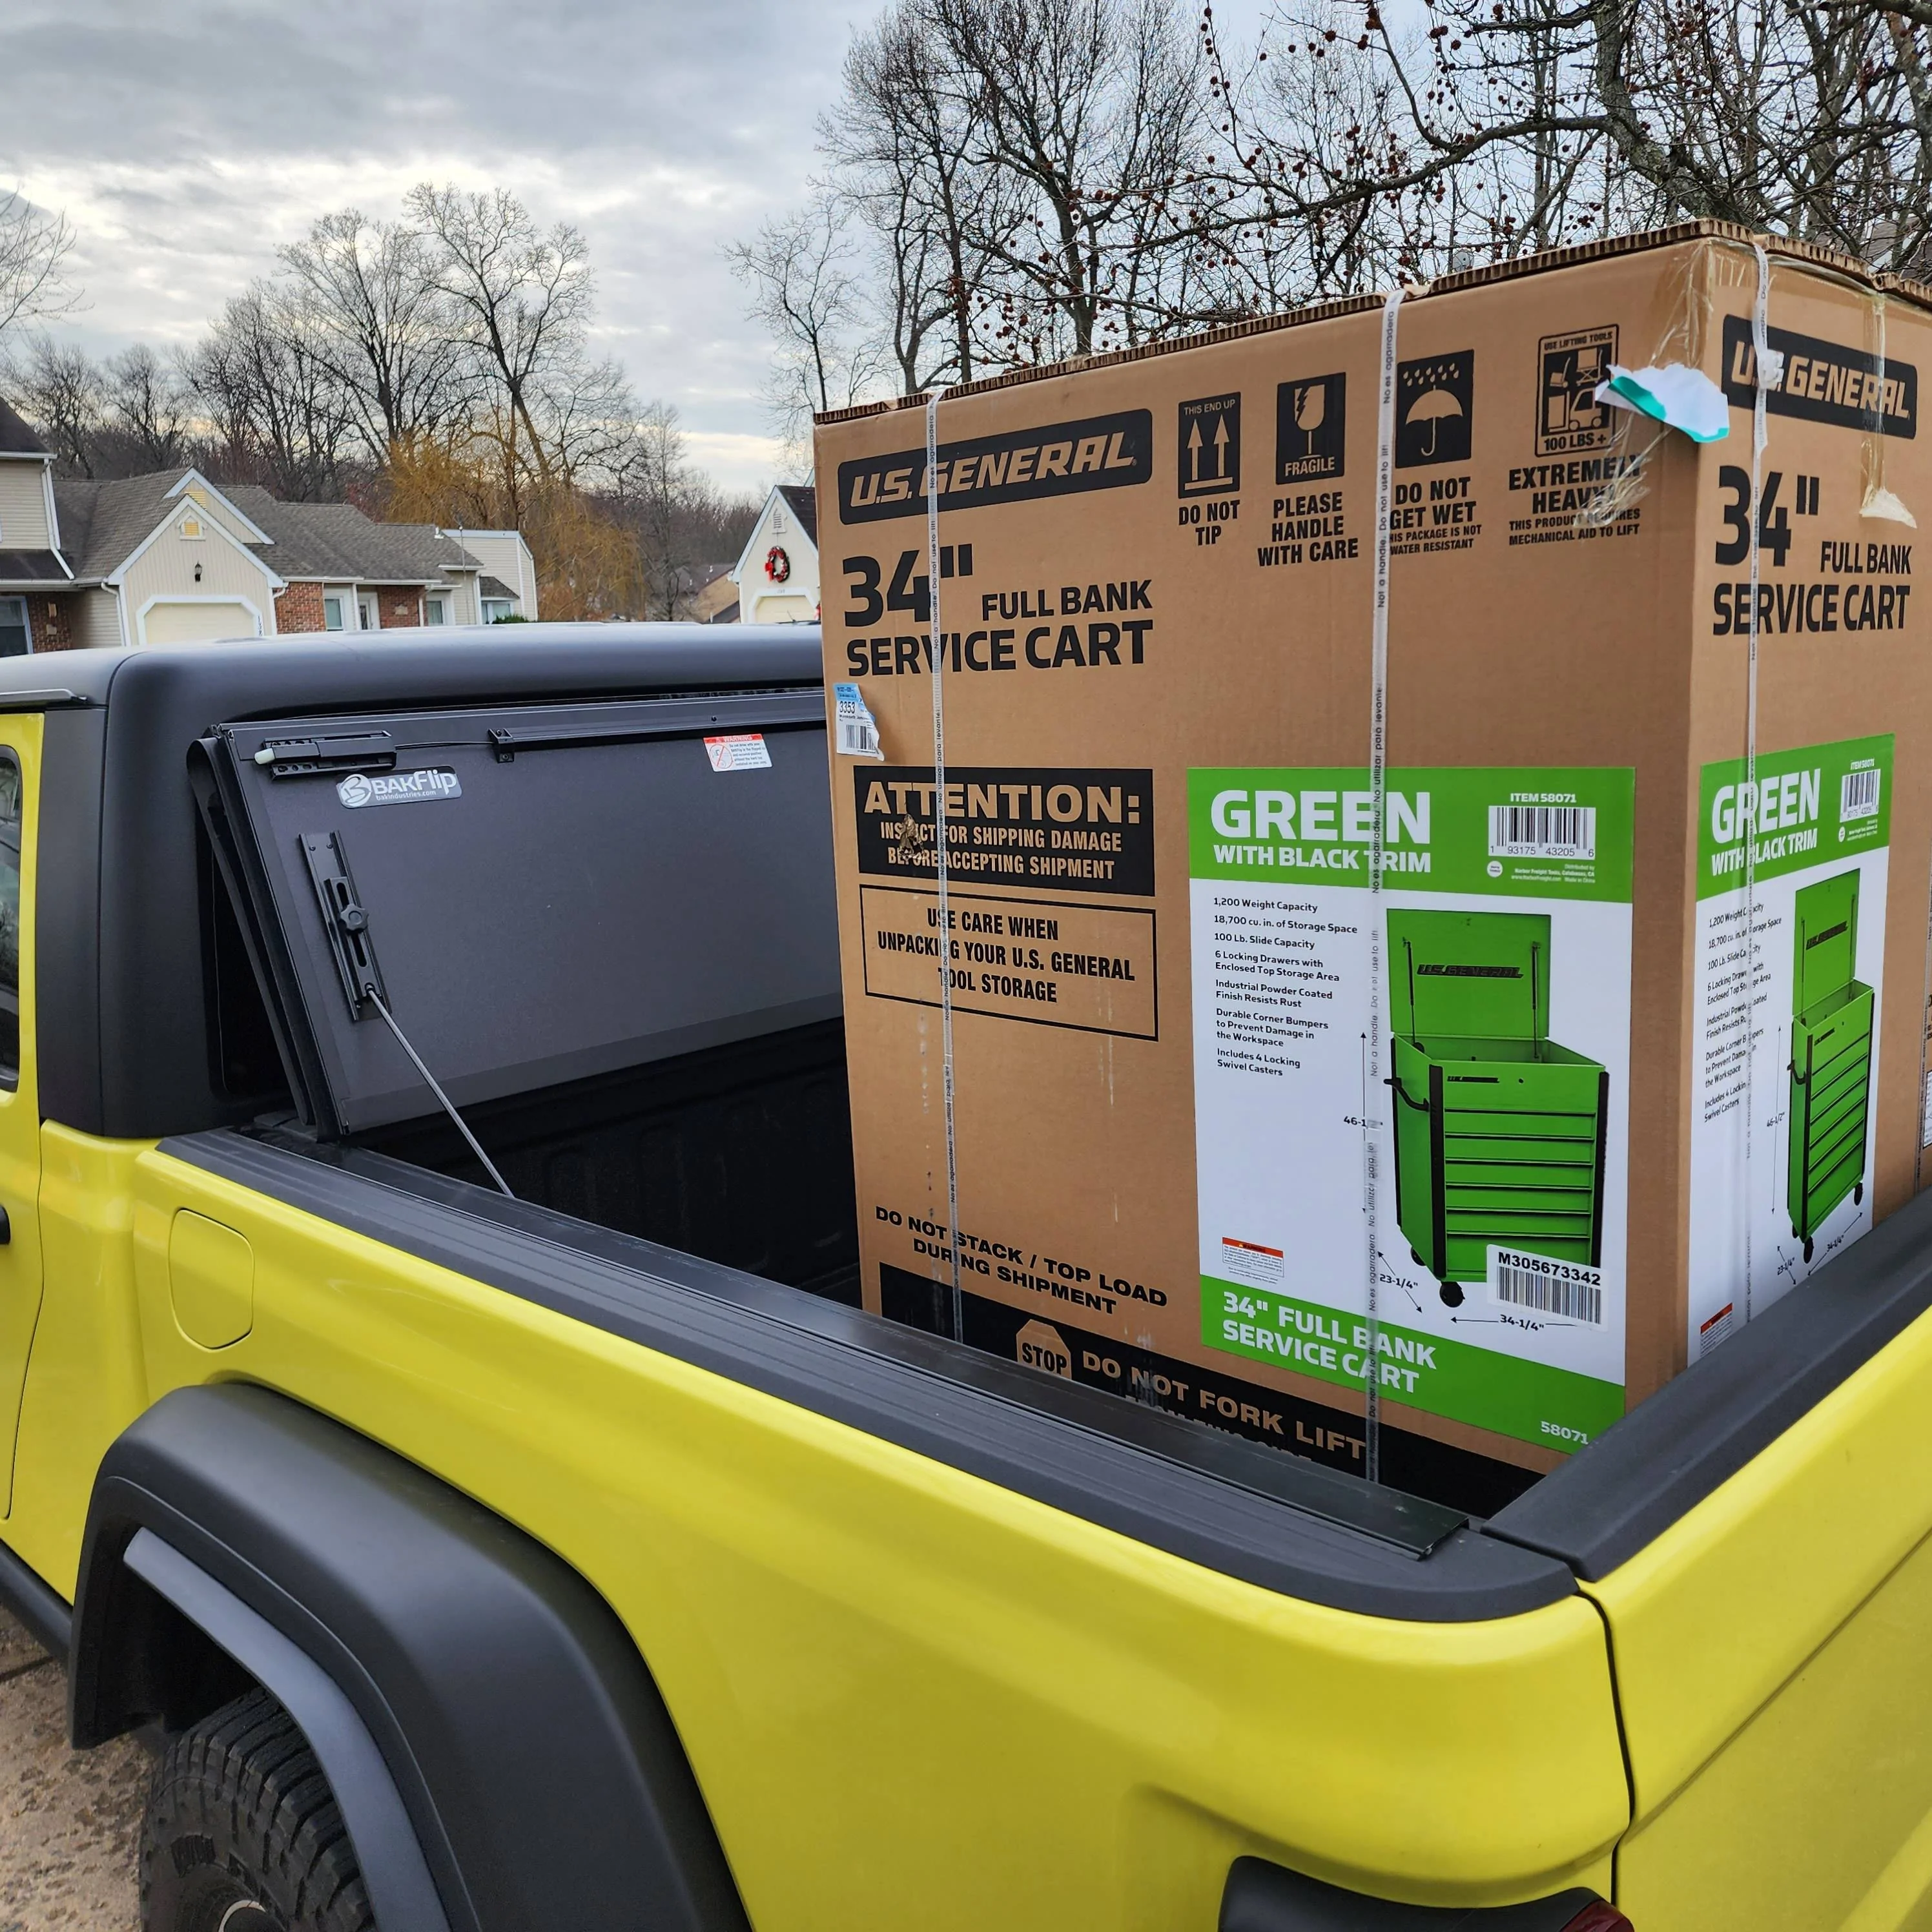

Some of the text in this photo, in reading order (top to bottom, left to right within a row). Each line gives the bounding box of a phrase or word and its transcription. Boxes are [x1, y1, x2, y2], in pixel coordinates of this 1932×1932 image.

[1786, 355, 1910, 419] GENERAL
[1184, 399, 1236, 416] THIS END UP
[1544, 432, 1595, 451] 100 LBS
[917, 431, 1135, 496] GENERAL
[1285, 457, 1335, 477] FRAGILE
[1395, 477, 1471, 505] DO NOT
[1179, 500, 1240, 526] DO NOT
[1273, 491, 1342, 519] PLEASE
[1390, 500, 1476, 530] GET WET
[1715, 465, 1820, 568] 34"
[1196, 525, 1222, 546] TIP
[1272, 516, 1344, 542] HANDLE
[1406, 524, 1482, 542] PACKAGE IS NOT
[1509, 520, 1532, 531] THIS
[1509, 524, 1640, 546] MECHANICAL AID TO LIFT
[1258, 538, 1358, 567] WITH CARE
[1390, 539, 1474, 556] WATER RESISTANT
[1820, 541, 1912, 575] FULL BANK
[842, 543, 974, 627] 34"
[981, 579, 1153, 621] FULL BANK
[1713, 583, 1911, 637] SERVICE CART
[847, 619, 1153, 676] SERVICE CART
[839, 701, 856, 714] 3353
[371, 769, 457, 796] BAKFlip
[375, 790, 437, 801] bakindustries.com
[863, 780, 1141, 825] ATTENTION:
[1510, 793, 1577, 803] ITEM 58071
[1711, 768, 1821, 845] GREEN
[1211, 789, 1430, 844] GREEN
[973, 827, 1045, 849] SHIPPING
[1051, 830, 1122, 853] DAMAGE
[1508, 847, 1575, 856] 93175 43205
[1711, 847, 1745, 877] WITH
[1788, 828, 1818, 855] TRIM
[946, 852, 1115, 880] ACCEPTING SHIPMENT
[1213, 844, 1431, 873] WITH BLACK TRIM
[1213, 898, 1318, 914] 1,200 Weight Capacity
[961, 912, 1003, 934] CARE
[1008, 916, 1058, 940] WHEN
[1214, 915, 1358, 934] 18,700 cu. in. of Storage Space
[1215, 933, 1315, 950] 100 Lb. Slide Capacity
[878, 930, 1136, 981] UNPACKIG YOUR U.S. GENERAL
[1223, 951, 1259, 963] Locking
[1260, 954, 1300, 966] Drawers
[1302, 958, 1323, 967] with
[1215, 961, 1340, 981] Enclosed Top Storage Area
[981, 974, 1058, 1002] STORAGE
[1215, 980, 1333, 1000] Industrial Powder Coated
[1216, 991, 1302, 1008] Finish Resists Rust
[1216, 1008, 1329, 1030] Durable Corner Bumpers
[1217, 1020, 1314, 1039] to Prevent Damage in
[1217, 1031, 1284, 1047] the Workspace
[1217, 1048, 1254, 1061] Includes
[1264, 1054, 1300, 1069] Locking
[1217, 1059, 1283, 1076] Swivel Casters
[876, 1206, 1167, 1306] DO NOT STACK TOP LOAD
[1498, 1251, 1601, 1286] M305673342
[913, 1238, 1117, 1315] DURNG SHIPMENT
[1223, 1291, 1437, 1370] 34" FULL BANK
[1499, 1313, 1545, 1331] 34-1/4"
[1022, 1342, 1067, 1375] STOP
[1222, 1319, 1420, 1393] SERVICE CART
[1083, 1350, 1122, 1379] DO
[1131, 1366, 1189, 1402] NOT
[1200, 1389, 1284, 1435] FORK
[1296, 1421, 1366, 1459] LIFT
[1539, 1421, 1589, 1446] 58071
